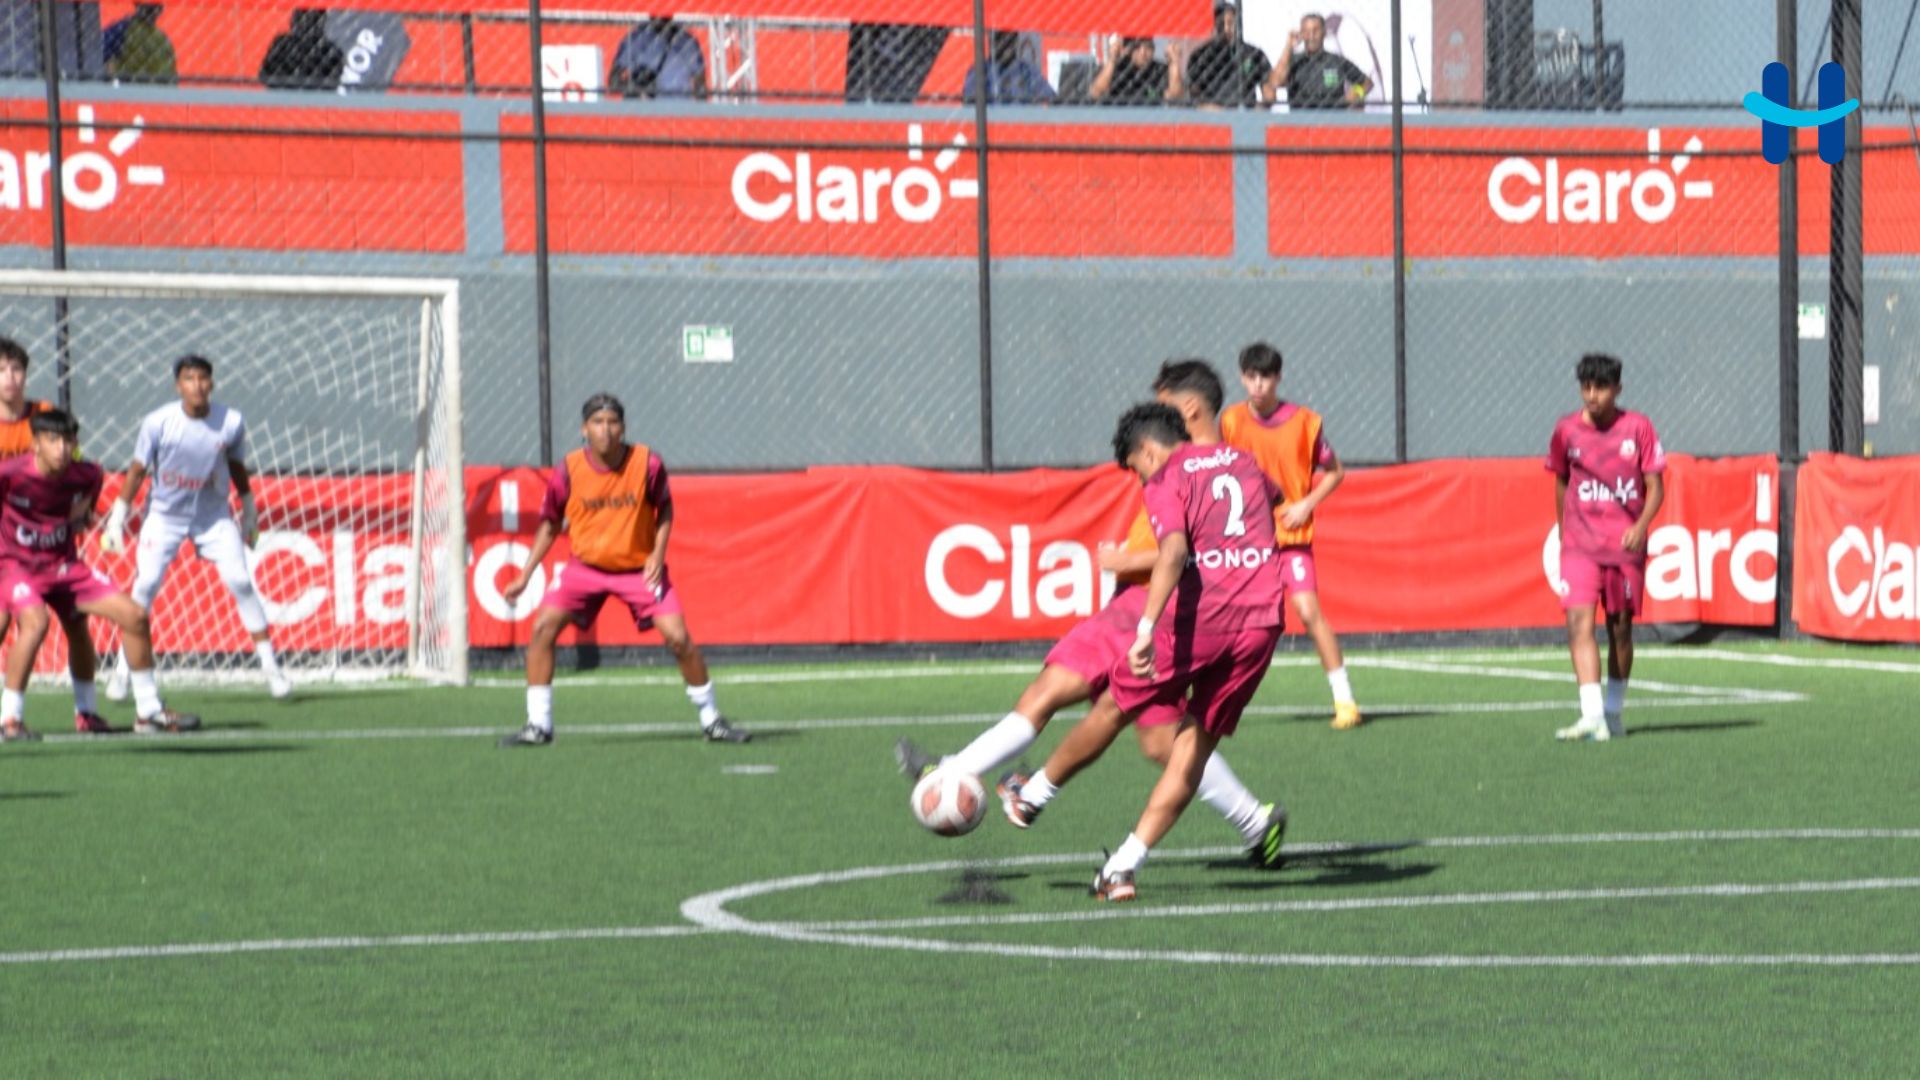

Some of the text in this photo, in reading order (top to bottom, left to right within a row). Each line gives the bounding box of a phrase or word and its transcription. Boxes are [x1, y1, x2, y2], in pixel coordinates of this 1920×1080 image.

[731, 151, 943, 223] Claro
[1487, 157, 1676, 223] Claro
[1212, 473, 1245, 536] 2
[925, 523, 1129, 619] Clar
[1292, 556, 1306, 582] 6
[1543, 521, 1779, 604] aro
[1827, 524, 1920, 619] Cla
